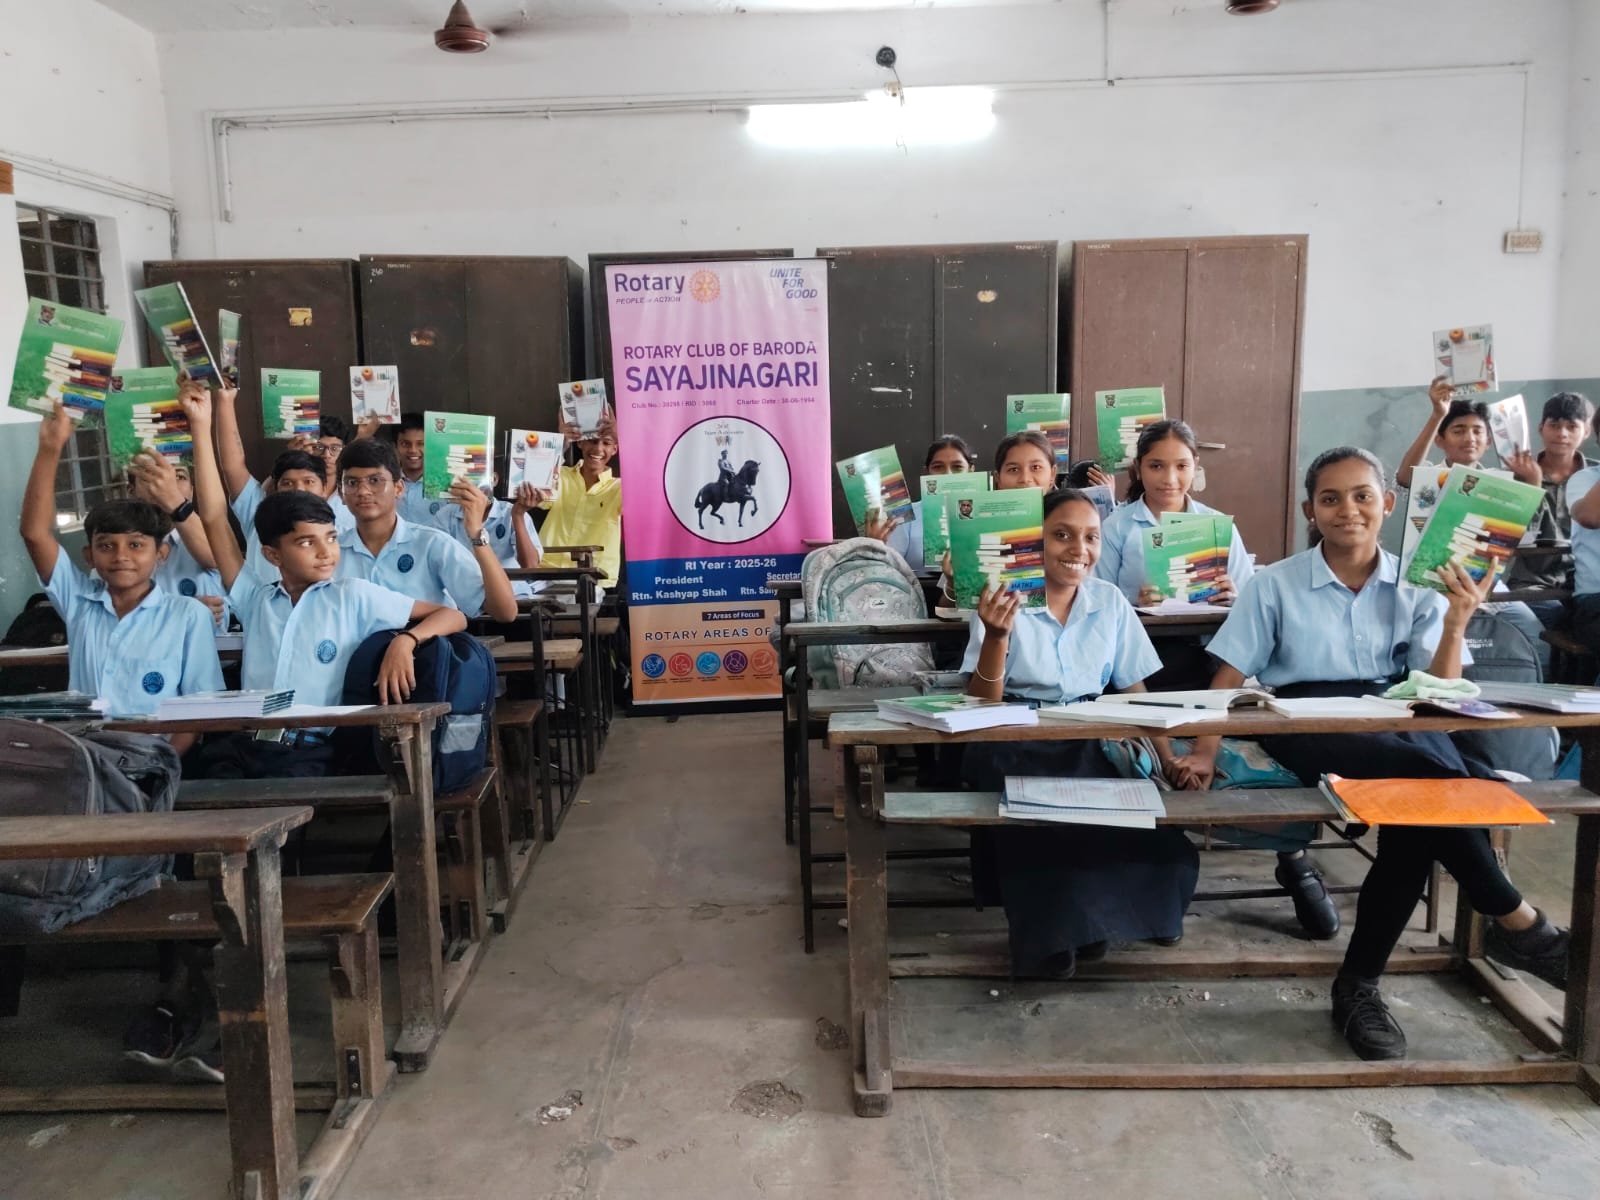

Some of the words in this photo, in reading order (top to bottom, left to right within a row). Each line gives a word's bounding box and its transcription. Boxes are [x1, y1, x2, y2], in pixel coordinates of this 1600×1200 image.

[770, 268, 802, 277] UNITE
[614, 273, 685, 294] Rotary
[783, 279, 804, 288] FOR
[786, 289, 818, 298] GOOD
[624, 345, 682, 360] ROTARY
[687, 343, 725, 358] CLUB
[730, 343, 748, 356] OF
[753, 341, 817, 355] BARODA
[626, 361, 818, 392] SAYAJINAGARI
[685, 561, 697, 570] RI
[700, 561, 725, 570] Year
[734, 558, 777, 569] 2025-26
[655, 576, 704, 585] President
[766, 572, 801, 580] Secretar
[632, 592, 653, 600] Rtn.
[656, 590, 699, 600] Kashyap
[702, 588, 727, 597] Shah
[740, 587, 757, 595] Rtn.
[645, 630, 697, 641] ROTARY
[704, 628, 749, 638] AREAS
[755, 627, 771, 637] OF
